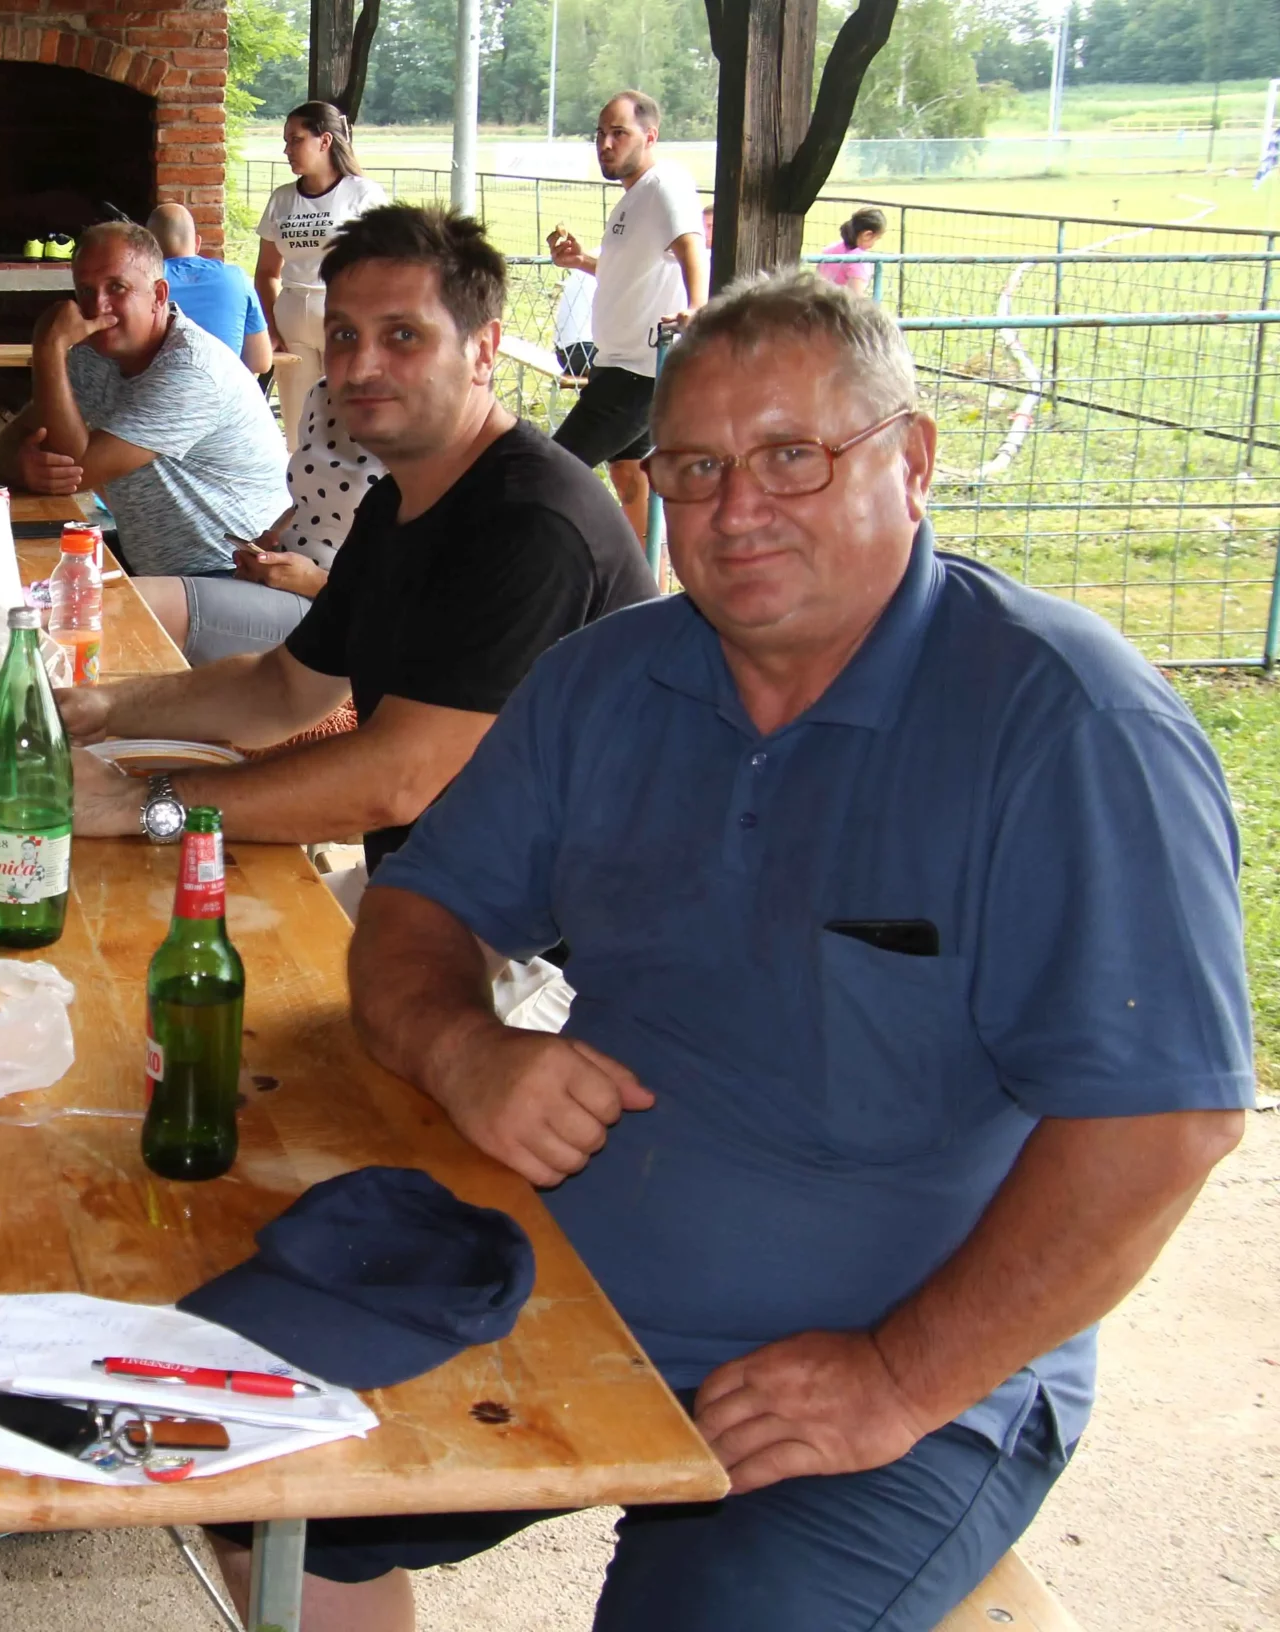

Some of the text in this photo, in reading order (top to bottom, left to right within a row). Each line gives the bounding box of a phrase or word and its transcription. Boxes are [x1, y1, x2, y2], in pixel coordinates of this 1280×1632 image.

[287, 212, 331, 220] L'AMOUR
[280, 221, 312, 230] COURT
[281, 229, 326, 239] RUES DE
[289, 240, 319, 249] PARIS
